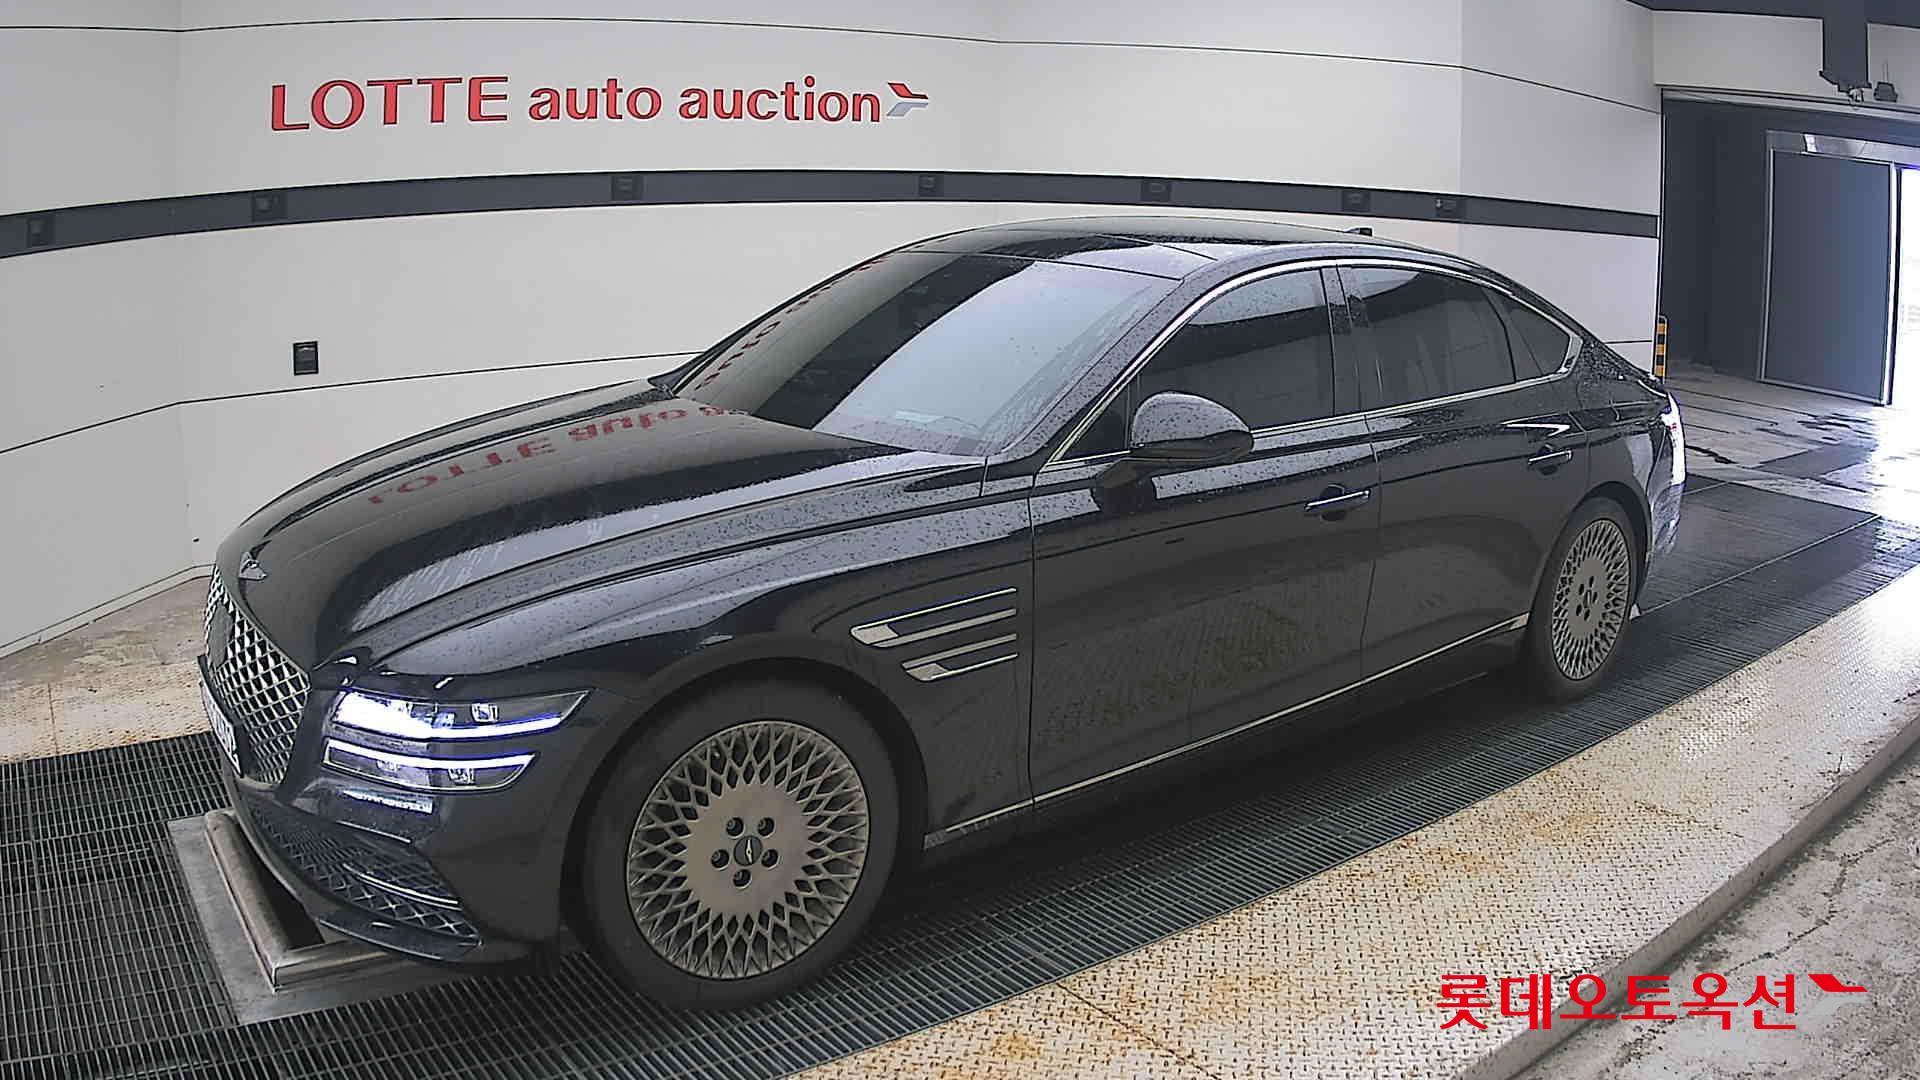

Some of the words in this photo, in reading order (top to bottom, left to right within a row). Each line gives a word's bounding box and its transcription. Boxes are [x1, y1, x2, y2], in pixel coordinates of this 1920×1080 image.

[271, 75, 508, 131] LOTTE
[528, 78, 662, 120] auto
[679, 75, 881, 122] auction
